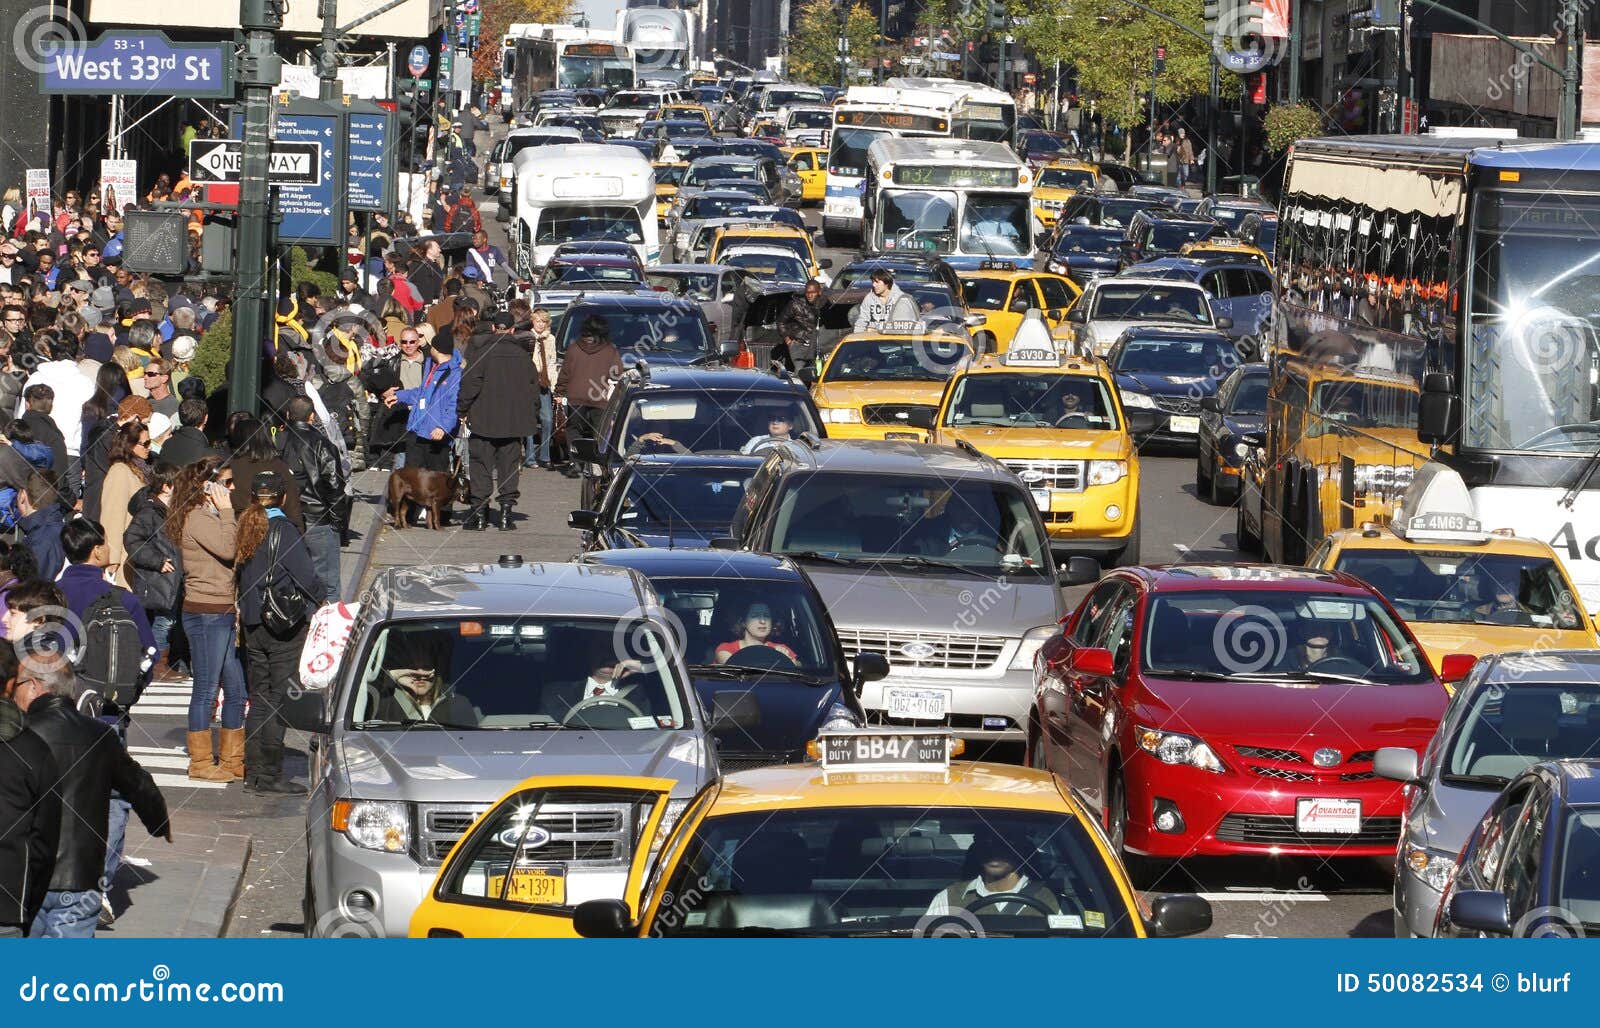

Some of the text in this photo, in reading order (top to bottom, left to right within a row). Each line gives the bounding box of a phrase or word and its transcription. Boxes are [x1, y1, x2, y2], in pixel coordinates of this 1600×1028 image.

[114, 40, 128, 50] 53
[139, 40, 145, 50] 1
[56, 54, 210, 81] West 33rd St
[293, 127, 319, 136] Broadway
[210, 154, 242, 170] ONE
[122, 176, 135, 184] SALE
[290, 193, 312, 201] Airport
[893, 321, 914, 330] 9H87
[1020, 350, 1043, 360] 3V30
[1428, 515, 1464, 530] 4M63
[917, 698, 940, 713] 9160
[832, 736, 849, 747] OFF
[922, 735, 940, 746] OFF
[856, 735, 915, 760] 6B47
[829, 749, 852, 761] DUTY
[919, 749, 943, 760] DUTY
[529, 878, 556, 897] 1391
